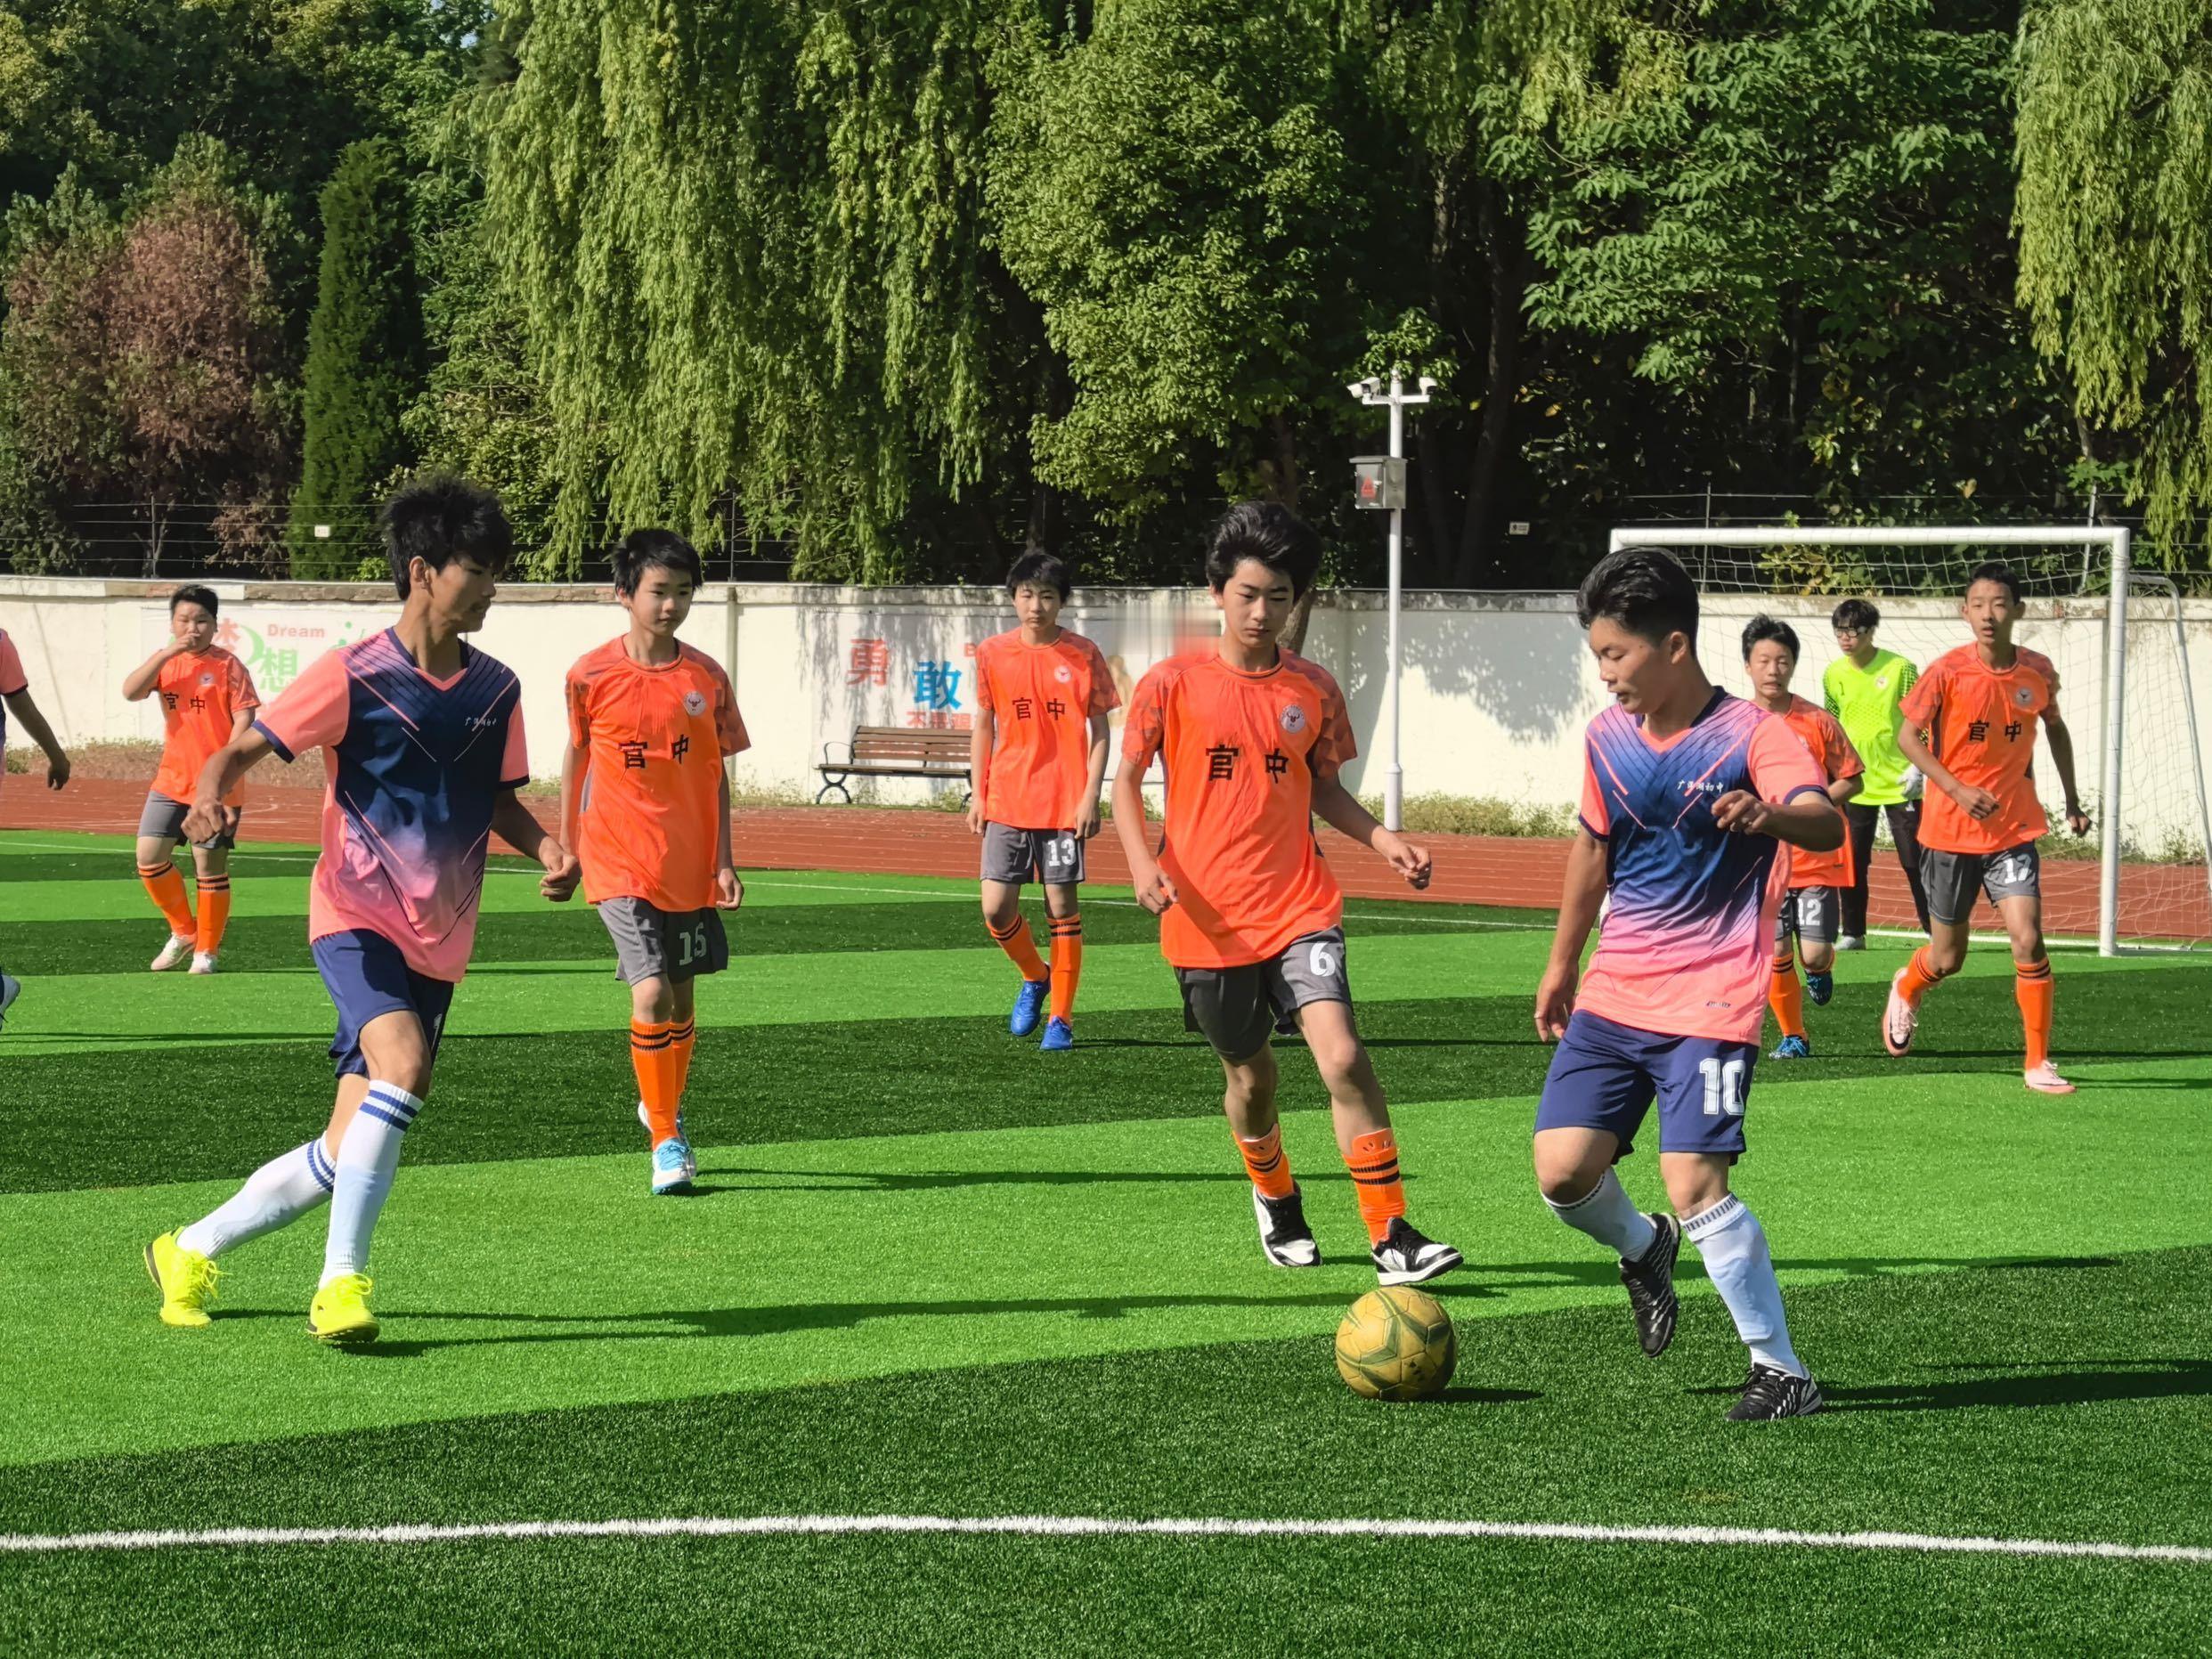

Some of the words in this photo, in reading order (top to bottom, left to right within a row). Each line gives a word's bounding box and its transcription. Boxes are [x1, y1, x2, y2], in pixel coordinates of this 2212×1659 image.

[267, 624, 325, 638] Dream
[846, 638, 963, 711] 勇敢
[163, 691, 206, 714] 官中
[1012, 696, 1066, 721] 官中
[1967, 720, 2022, 743] 官中
[618, 734, 689, 769] 官中
[1205, 744, 1289, 784] 官中
[1047, 838, 1076, 866] 13
[2003, 853, 2031, 884] 17
[1797, 898, 1821, 926] 12
[679, 922, 707, 966] 15
[1309, 940, 1336, 977] 6
[1699, 1057, 1746, 1115] 10
